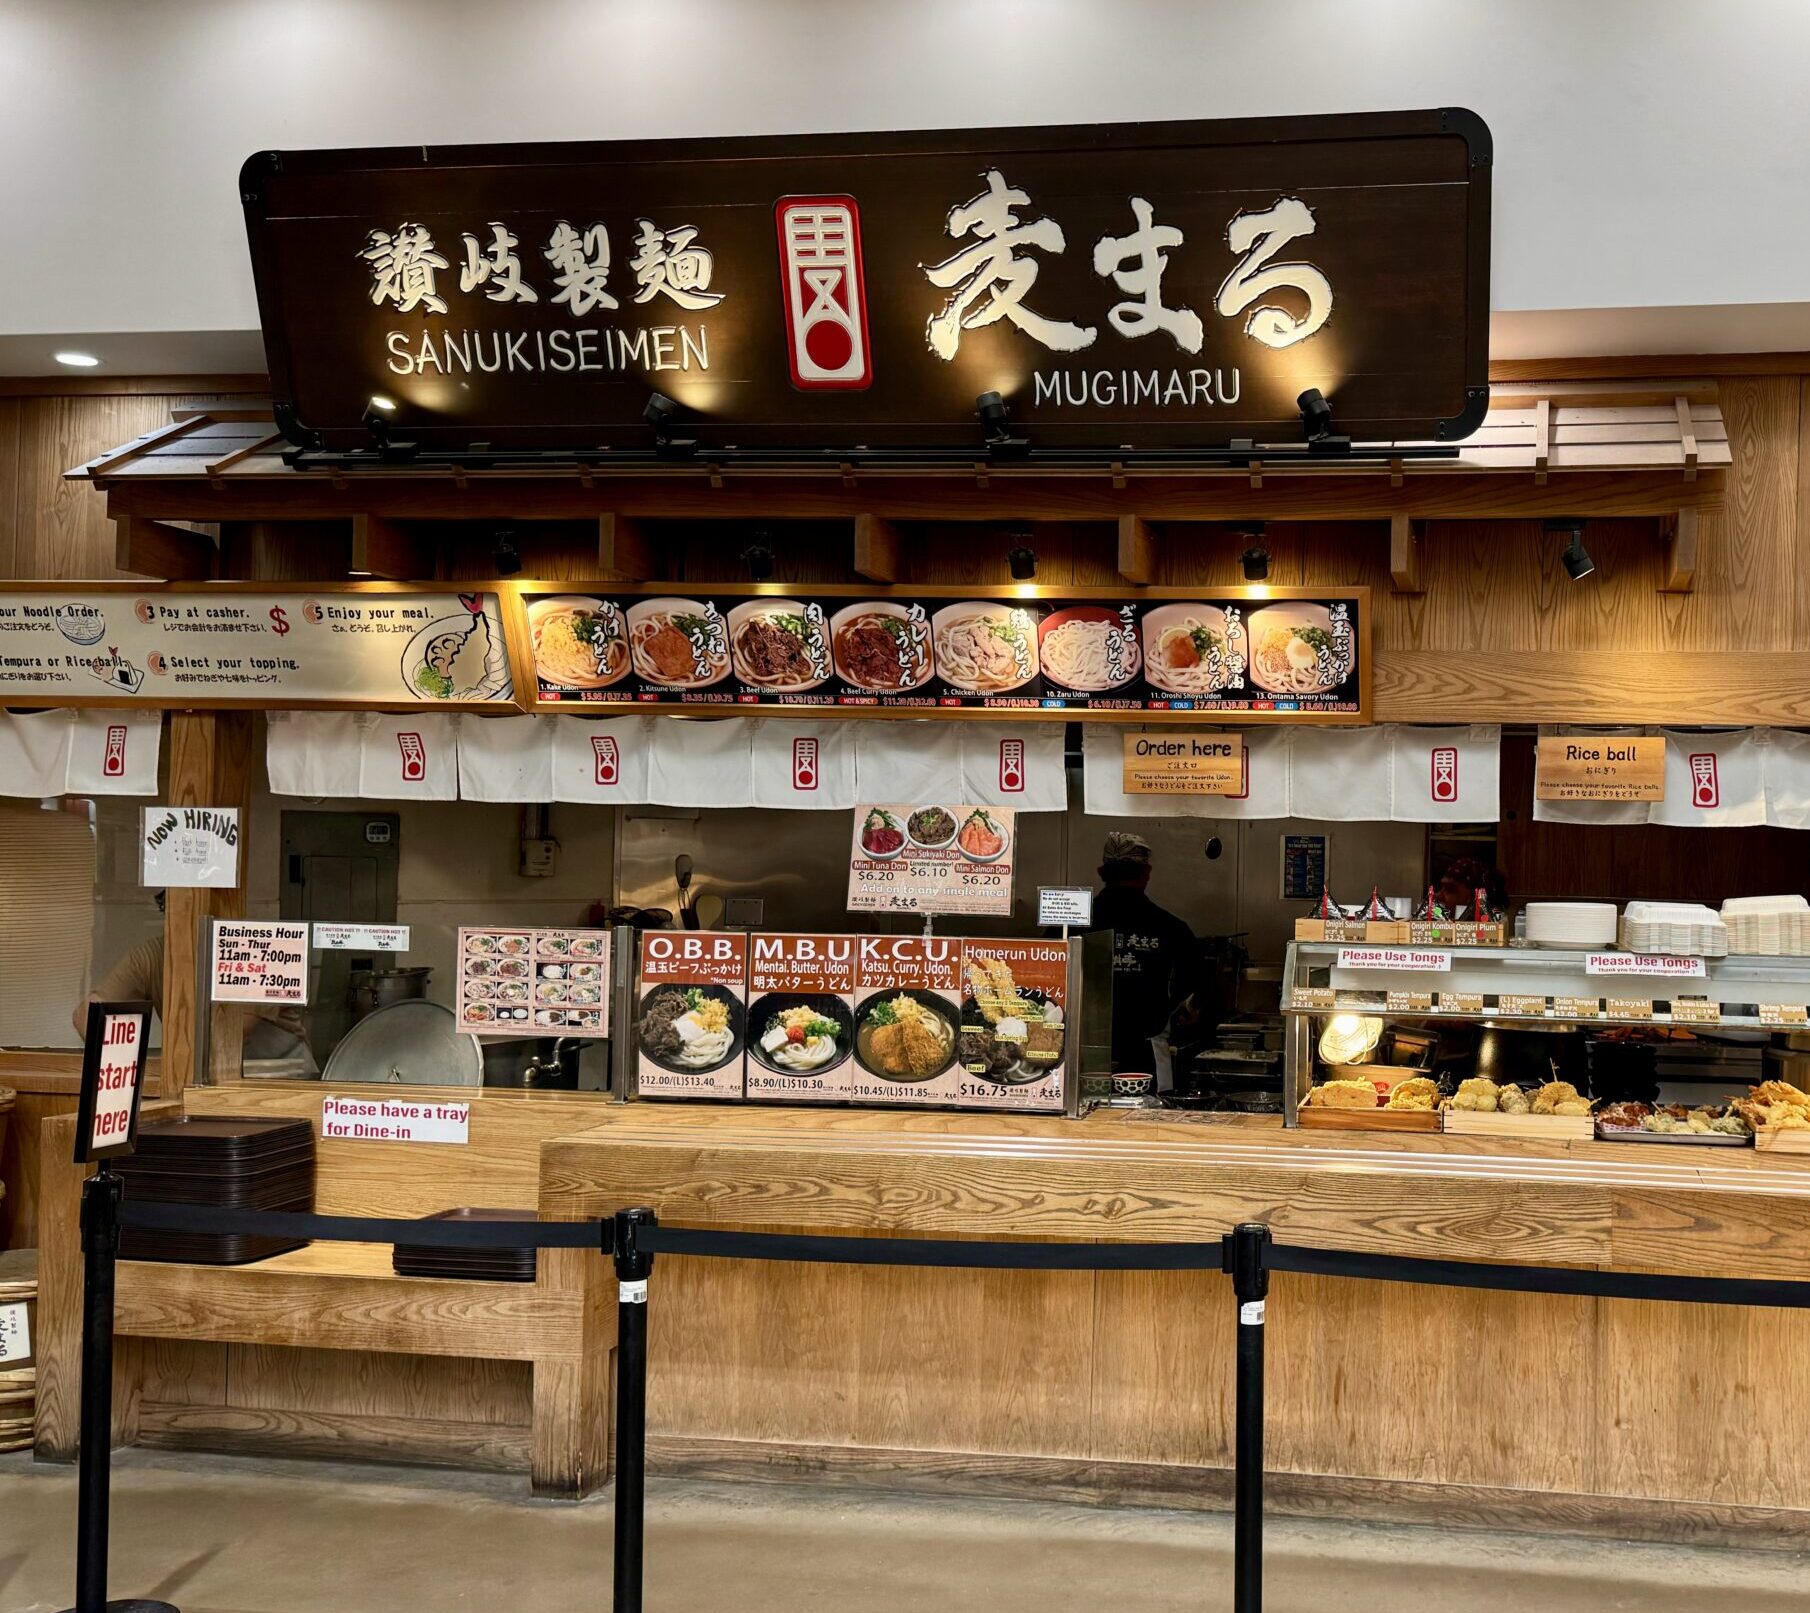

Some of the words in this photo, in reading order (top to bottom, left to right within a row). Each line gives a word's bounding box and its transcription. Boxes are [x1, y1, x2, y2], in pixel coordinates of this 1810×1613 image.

[918, 167, 1335, 361] 麦まる
[386, 324, 709, 375] SANUKISEIMEN
[1033, 368, 1241, 406] MUGIMARU
[24, 606, 62, 618] Noodle
[67, 606, 104, 618] Order.
[146, 606, 155, 619] 3
[160, 607, 180, 618] Pay
[186, 607, 198, 618] at
[206, 608, 250, 618] casher.
[314, 607, 324, 620] 5
[328, 607, 362, 620] Enjoy
[369, 609, 396, 620] your
[402, 607, 434, 619] meal.
[602, 600, 620, 637] かけ
[704, 600, 726, 654] きつね
[1119, 604, 1136, 642] ざる
[906, 602, 927, 665] カレー
[590, 625, 612, 675] うどん
[690, 627, 711, 677] うどん
[1106, 630, 1126, 680] うどん
[0, 656, 42, 668] Tempura
[48, 657, 60, 667] or
[66, 656, 92, 667] Rice
[158, 657, 167, 670] 4
[172, 656, 210, 668] Select
[217, 658, 242, 670] your
[250, 657, 300, 671] topping.
[896, 630, 916, 686] うどん
[1207, 646, 1225, 690] うどん
[1317, 645, 1332, 686] うどん
[862, 688, 879, 696] Curry
[950, 688, 976, 696] Chicken
[1183, 692, 1203, 700] Shoyu
[1296, 693, 1318, 701] Savory
[1136, 739, 1186, 756] Order
[1192, 740, 1232, 756] here
[1566, 745, 1600, 760] Rice
[1606, 746, 1636, 761] ball
[1586, 766, 1616, 775] おにぎり
[147, 812, 178, 850] NOW
[184, 808, 238, 847] HIRING
[903, 850, 918, 858] Mini
[918, 850, 946, 859] Sukiyaki
[854, 861, 870, 869] Mini
[872, 862, 890, 870] Tuna
[891, 862, 907, 870] Don
[994, 866, 1009, 874] Don
[858, 871, 894, 881] $6.20
[910, 867, 948, 878] $6.10
[962, 876, 1001, 886] $6.20
[861, 883, 882, 893] Add
[886, 886, 900, 894] on
[904, 885, 914, 894] to
[918, 886, 938, 896] any
[978, 886, 1008, 897] meal
[1326, 920, 1344, 929] Onigiri
[1344, 920, 1366, 928] Salmon
[1411, 922, 1430, 932] Onigiri
[1432, 922, 1452, 930] Kombu
[1456, 923, 1478, 932] Onigiri
[218, 926, 272, 938] Business
[276, 927, 304, 939] Hour
[1324, 934, 1346, 942] $2.25
[218, 939, 238, 948] Sun
[248, 940, 271, 950] Thur
[1412, 936, 1432, 944] $2.25
[1456, 938, 1477, 946] $2.25
[649, 937, 742, 960] O.B.B.
[860, 938, 959, 962] K.C.U.
[964, 946, 1026, 961] Homerun
[1030, 946, 1066, 962] Udon
[218, 950, 250, 962] 11am
[260, 950, 301, 963] 7:00pm
[1342, 950, 1382, 960] Please
[1385, 952, 1406, 961] Use
[1410, 952, 1445, 964] Tongs
[1590, 956, 1632, 966] Please
[1635, 956, 1658, 966] Use
[1660, 958, 1698, 969] Tongs
[218, 962, 232, 972] Fri
[235, 962, 244, 972] &
[247, 963, 266, 973] Sat
[645, 961, 742, 976] 温玉ビーフぶっかけ
[755, 960, 790, 973] Mentai.
[791, 960, 822, 974] Butter.
[825, 961, 849, 974] Udon
[862, 960, 890, 972] Katsu.
[893, 960, 922, 976] Curry.
[924, 962, 953, 975] Udon.
[218, 973, 250, 986] 11am
[259, 974, 300, 988] 7:30pm
[754, 976, 851, 990] 明太バターうどん
[862, 974, 954, 990] カツカレーうどん
[964, 983, 1064, 998] 名物ホームランうどん
[1294, 988, 1312, 996] Sweet
[1442, 992, 1454, 1000] Egg
[1608, 1000, 1649, 1008] Takoyaki
[102, 1016, 136, 1045] ine
[967, 1064, 985, 1072] Beef
[640, 1076, 715, 1087] $12.00/(L)$13.40
[748, 1077, 823, 1090] $8.90/(L)$10.30
[854, 1085, 928, 1097] $10.45/(L)$11.85
[960, 1083, 1007, 1097] $16.75
[324, 1101, 376, 1116] Please
[381, 1103, 419, 1118] have
[423, 1107, 432, 1118] a
[437, 1106, 468, 1124] tray
[327, 1122, 350, 1136] for
[354, 1124, 411, 1139] Dine-in
